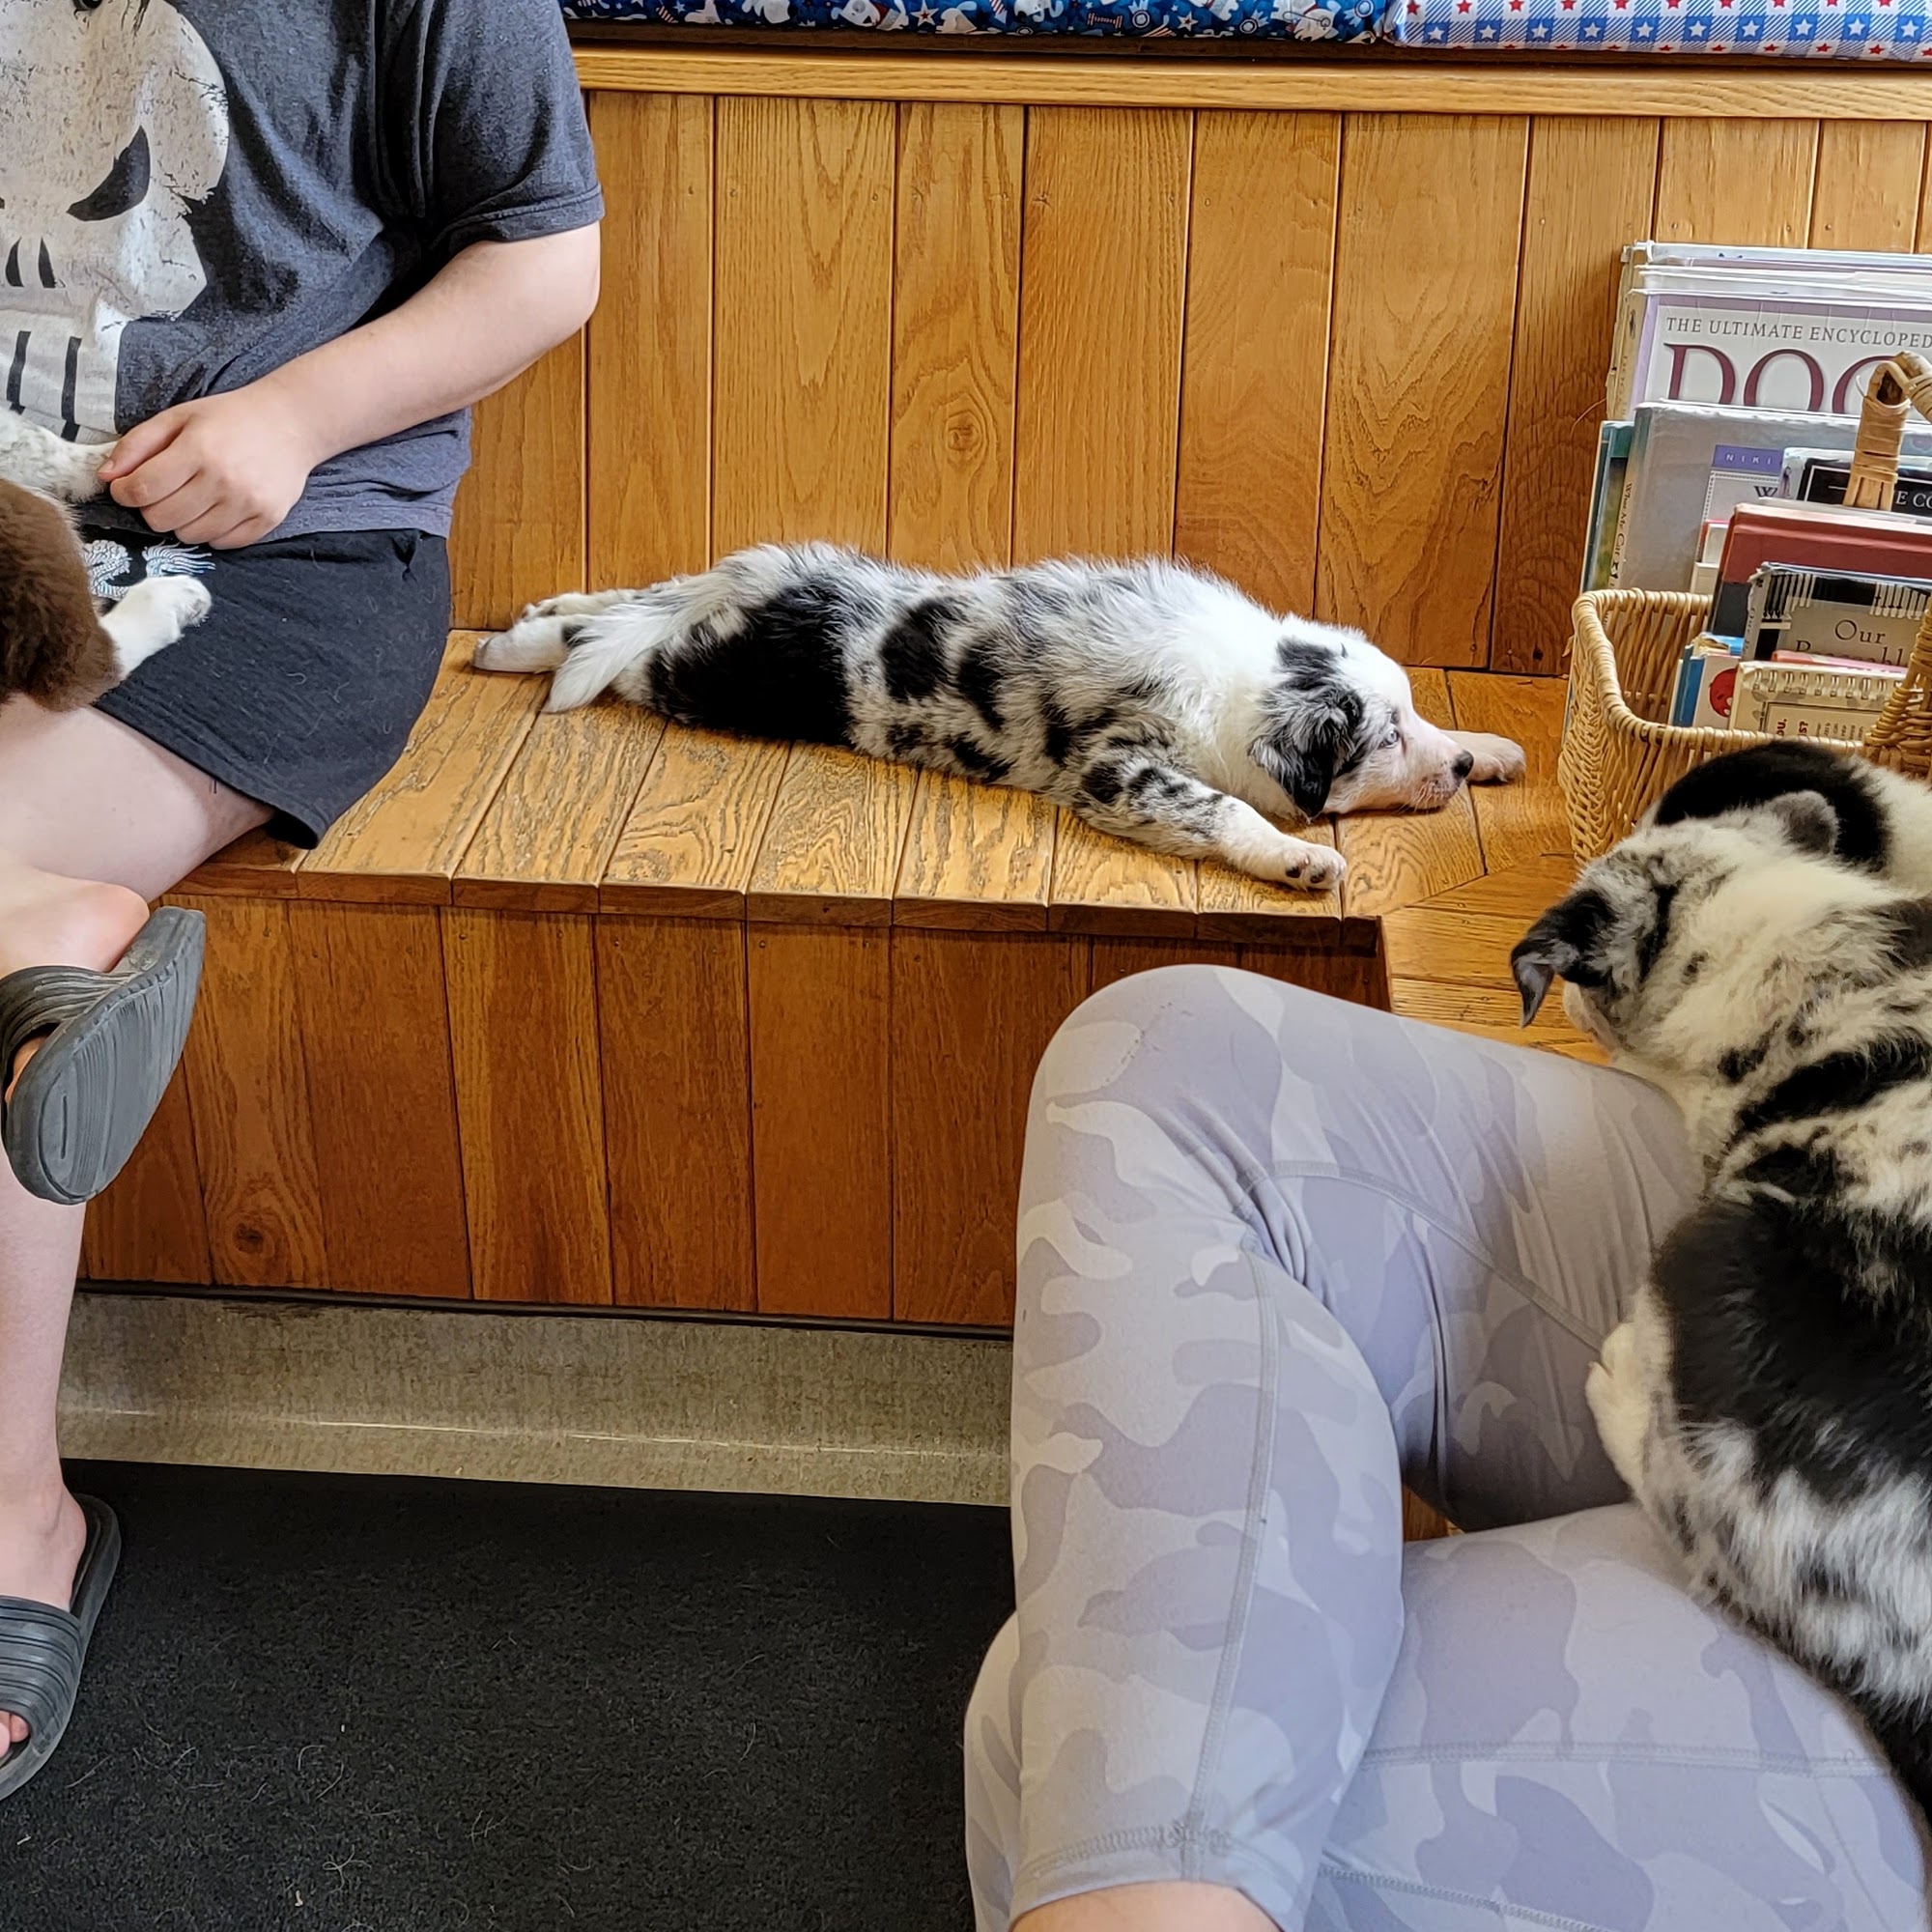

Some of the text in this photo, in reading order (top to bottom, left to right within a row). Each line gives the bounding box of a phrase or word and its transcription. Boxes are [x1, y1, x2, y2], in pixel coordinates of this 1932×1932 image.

[1666, 317, 1702, 333] THE
[1709, 320, 1804, 339] ULTIMATE
[1725, 453, 1772, 465] NIKI
[1835, 619, 1886, 644] Our
